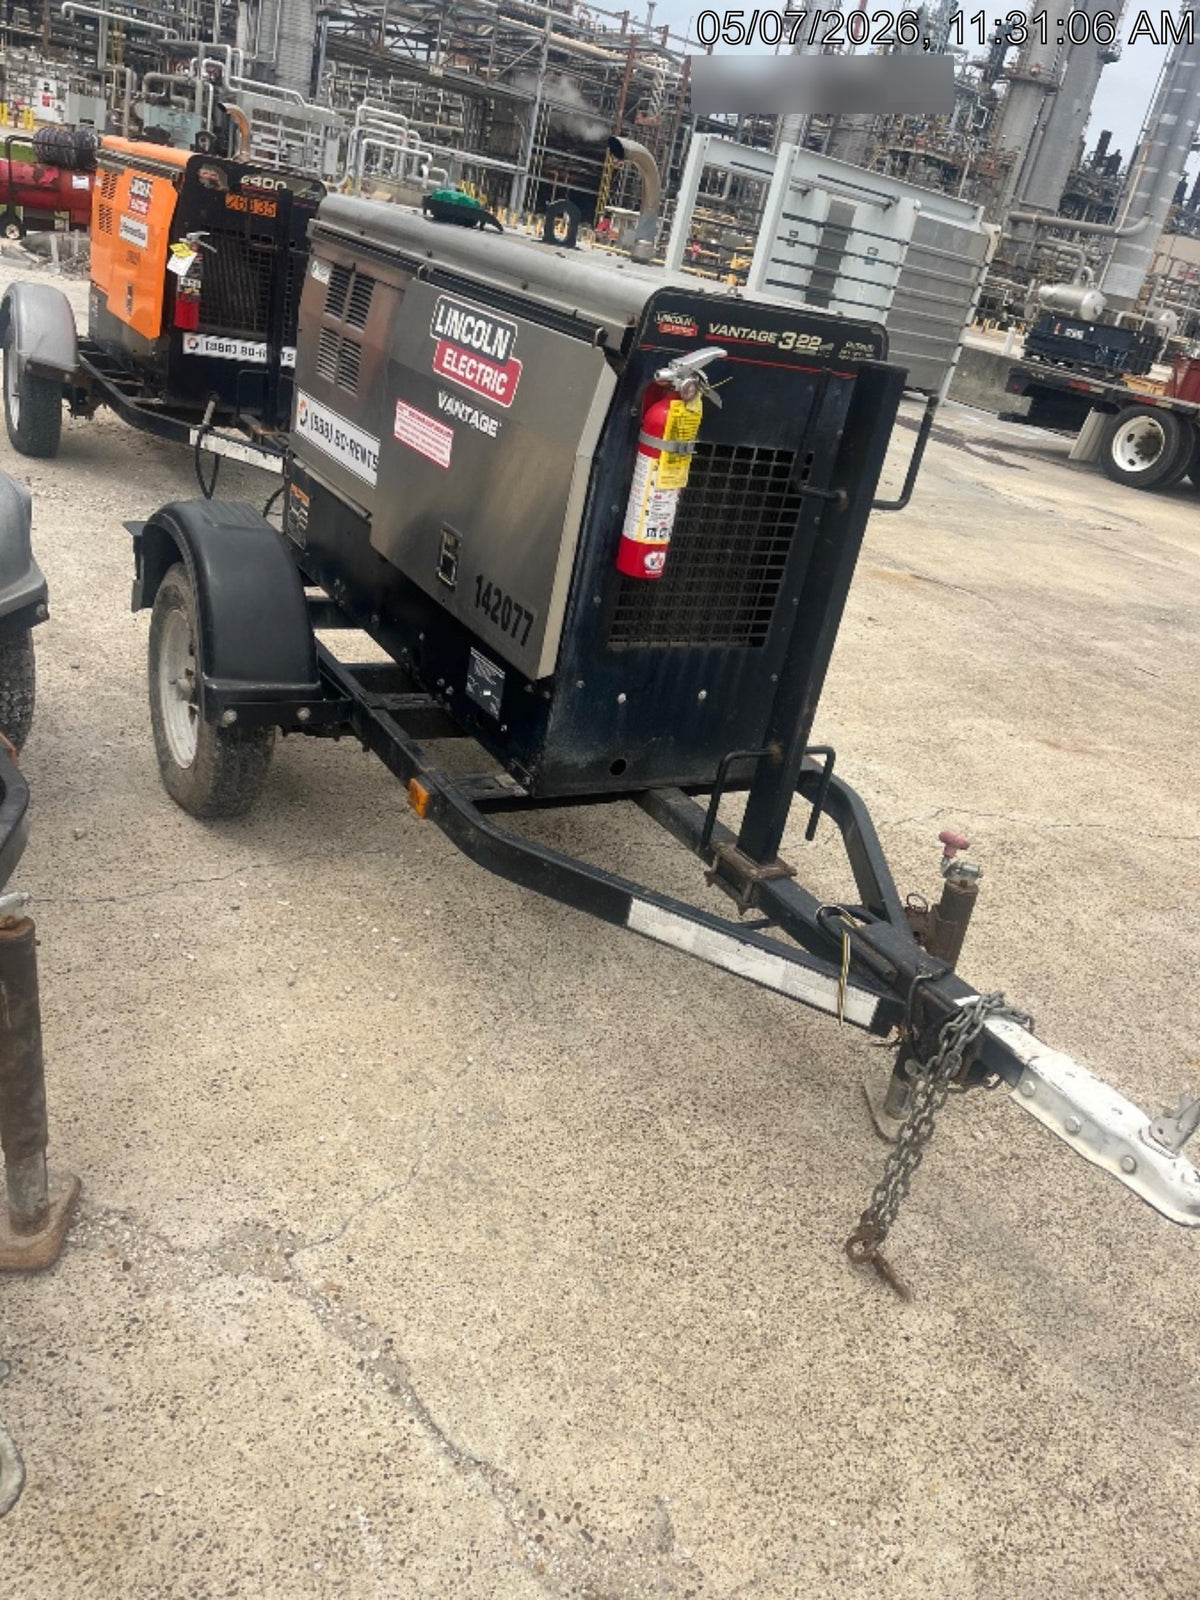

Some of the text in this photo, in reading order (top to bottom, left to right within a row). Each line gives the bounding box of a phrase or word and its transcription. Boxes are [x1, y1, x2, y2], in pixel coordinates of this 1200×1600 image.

[435, 304, 511, 360] LINCOLN
[708, 323, 779, 344] VANTAGE
[778, 331, 822, 351] 322
[442, 348, 509, 395] ELECTRIC
[438, 390, 499, 438] VANTAGE
[475, 574, 534, 647] 142077
